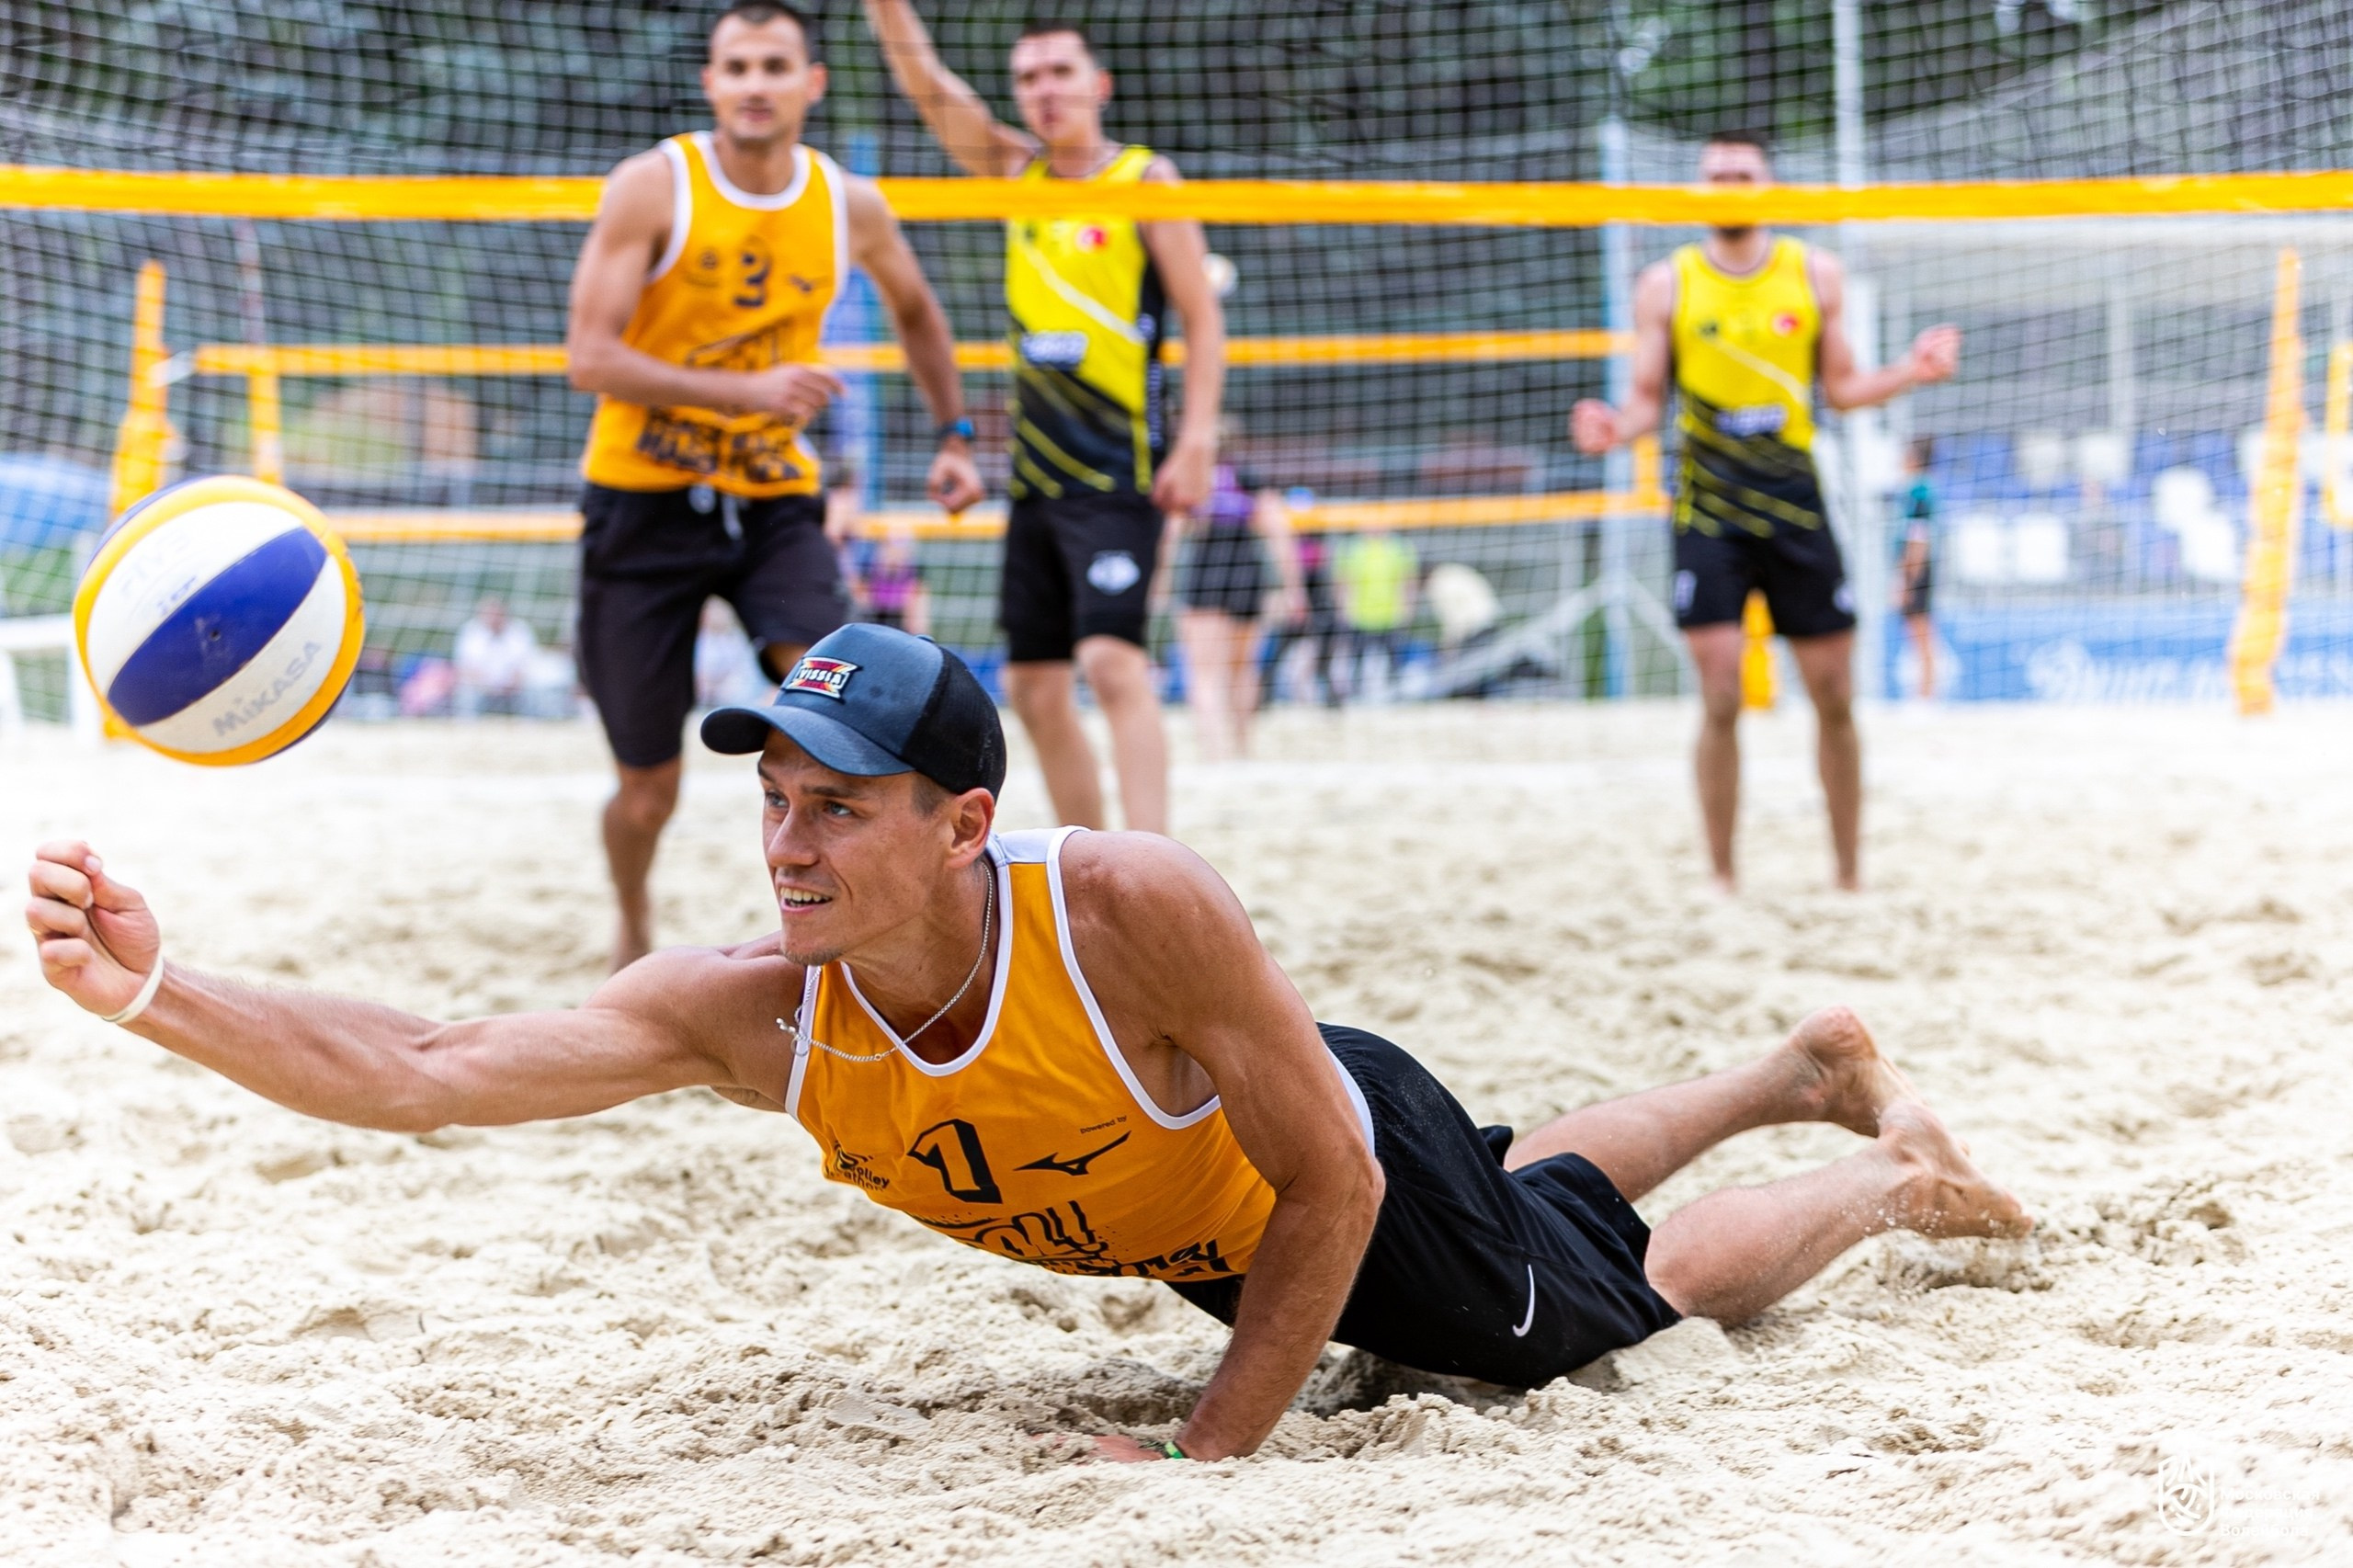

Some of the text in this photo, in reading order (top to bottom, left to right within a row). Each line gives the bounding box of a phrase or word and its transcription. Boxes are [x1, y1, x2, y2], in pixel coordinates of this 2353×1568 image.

[1079, 1114, 1128, 1134] powered by
[906, 1118, 1004, 1204] 1
